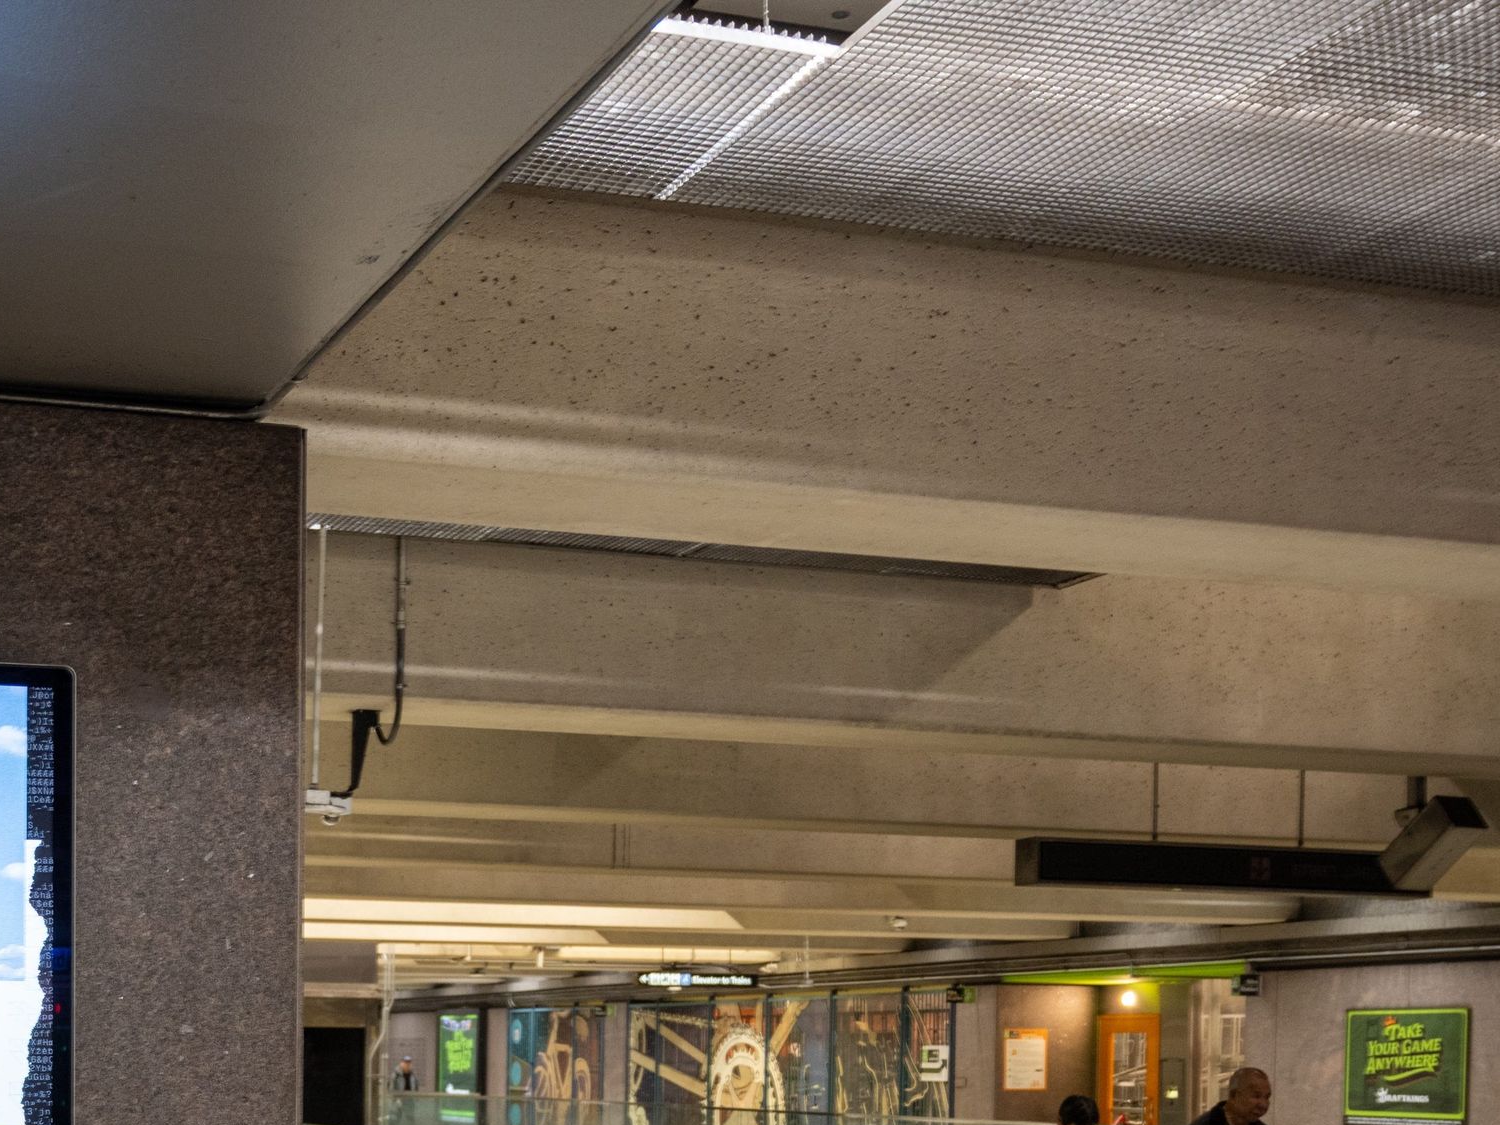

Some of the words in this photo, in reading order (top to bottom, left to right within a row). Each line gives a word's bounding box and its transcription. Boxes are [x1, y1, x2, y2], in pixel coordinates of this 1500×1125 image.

[1384, 1023, 1424, 1041] TAKE
[1367, 1041, 1399, 1056] YOUR
[1402, 1038, 1442, 1054] GAME
[1364, 1054, 1439, 1075] ANYWHERE
